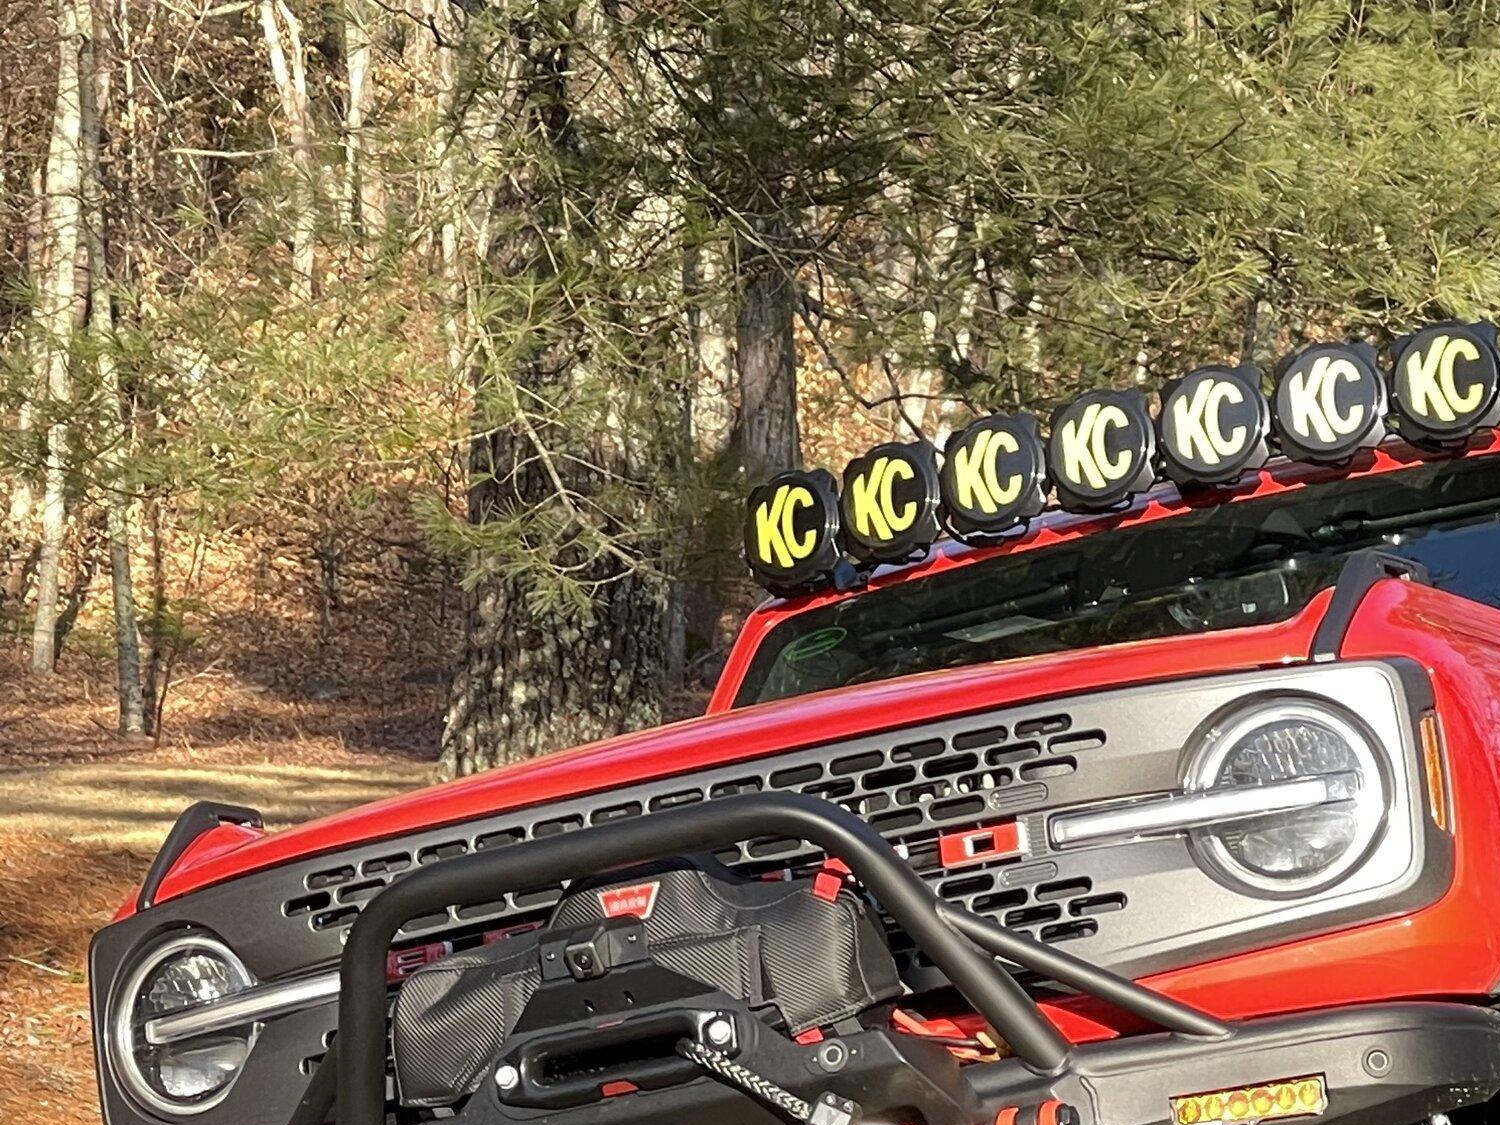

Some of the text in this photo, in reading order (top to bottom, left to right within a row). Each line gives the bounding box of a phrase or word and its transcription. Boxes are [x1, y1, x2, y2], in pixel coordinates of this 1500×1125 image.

[1289, 356, 1365, 443] KC
[1406, 335, 1484, 422] KC
[1062, 404, 1133, 489] KC
[1173, 378, 1247, 465] KC
[853, 457, 917, 540] KC
[955, 429, 1023, 513] KC
[756, 485, 817, 568] KC
